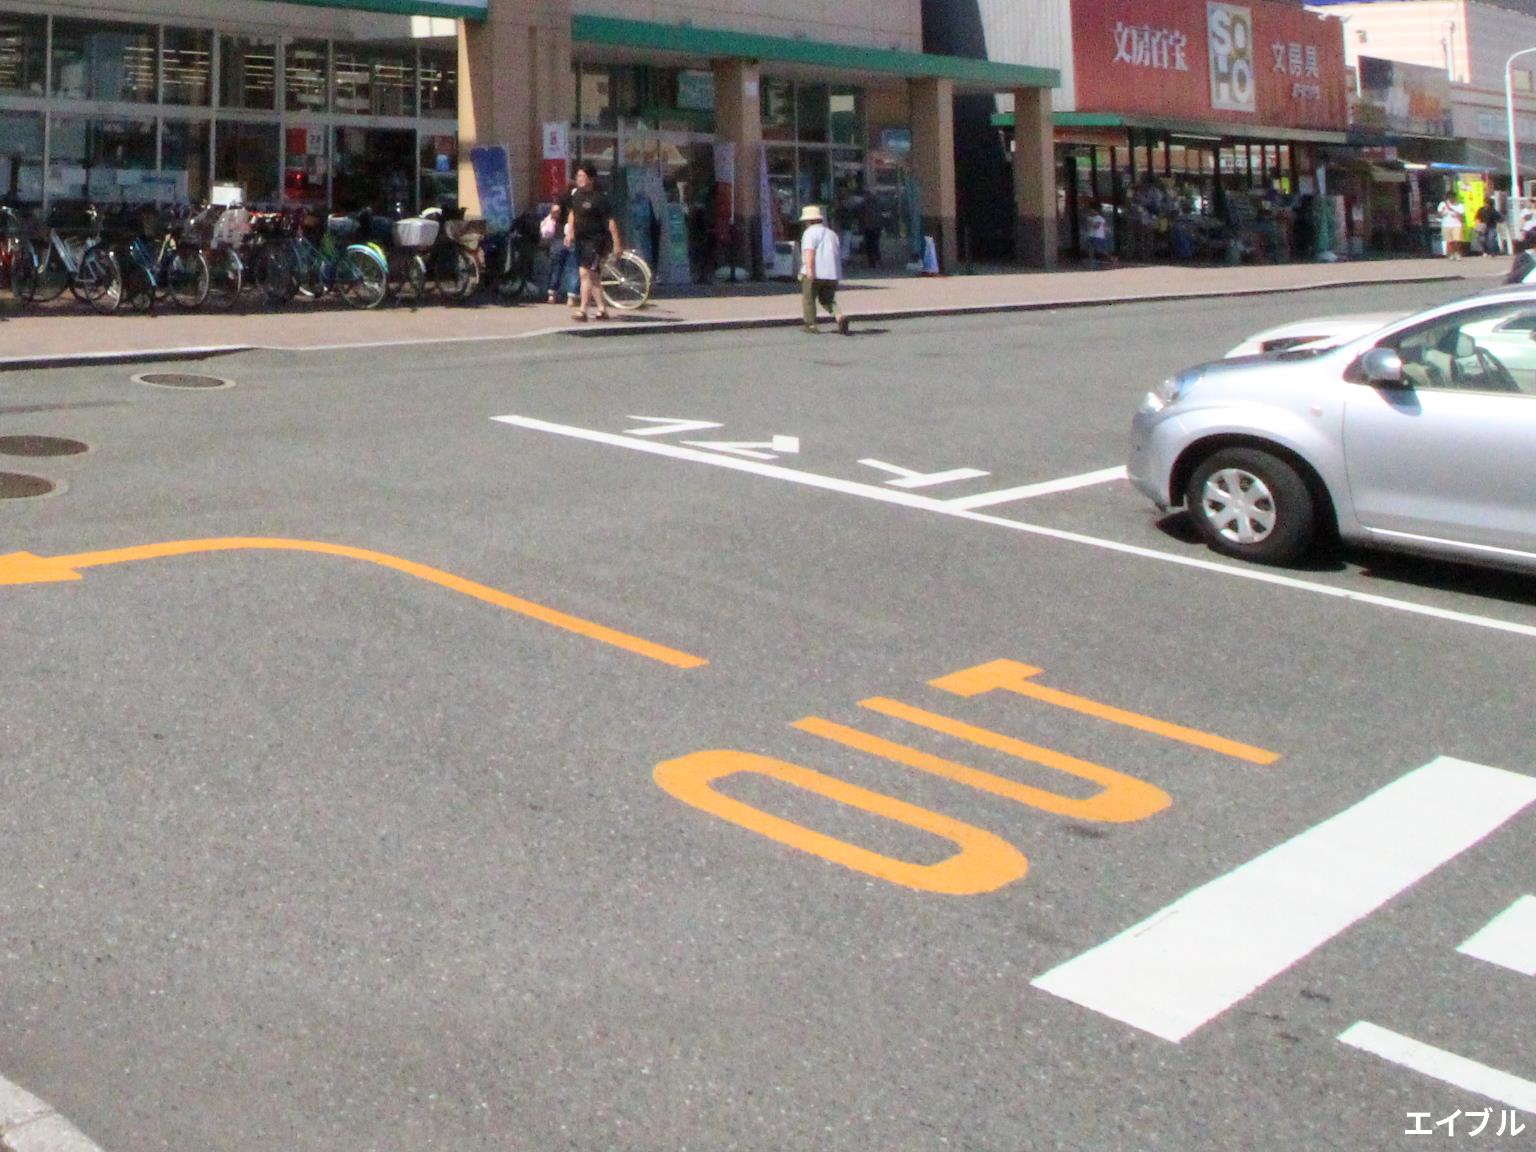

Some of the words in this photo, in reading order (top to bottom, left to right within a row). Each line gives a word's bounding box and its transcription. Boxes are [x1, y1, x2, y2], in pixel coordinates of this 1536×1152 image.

[1273, 42, 1319, 78] 文房具
[653, 658, 1281, 896] OUT
